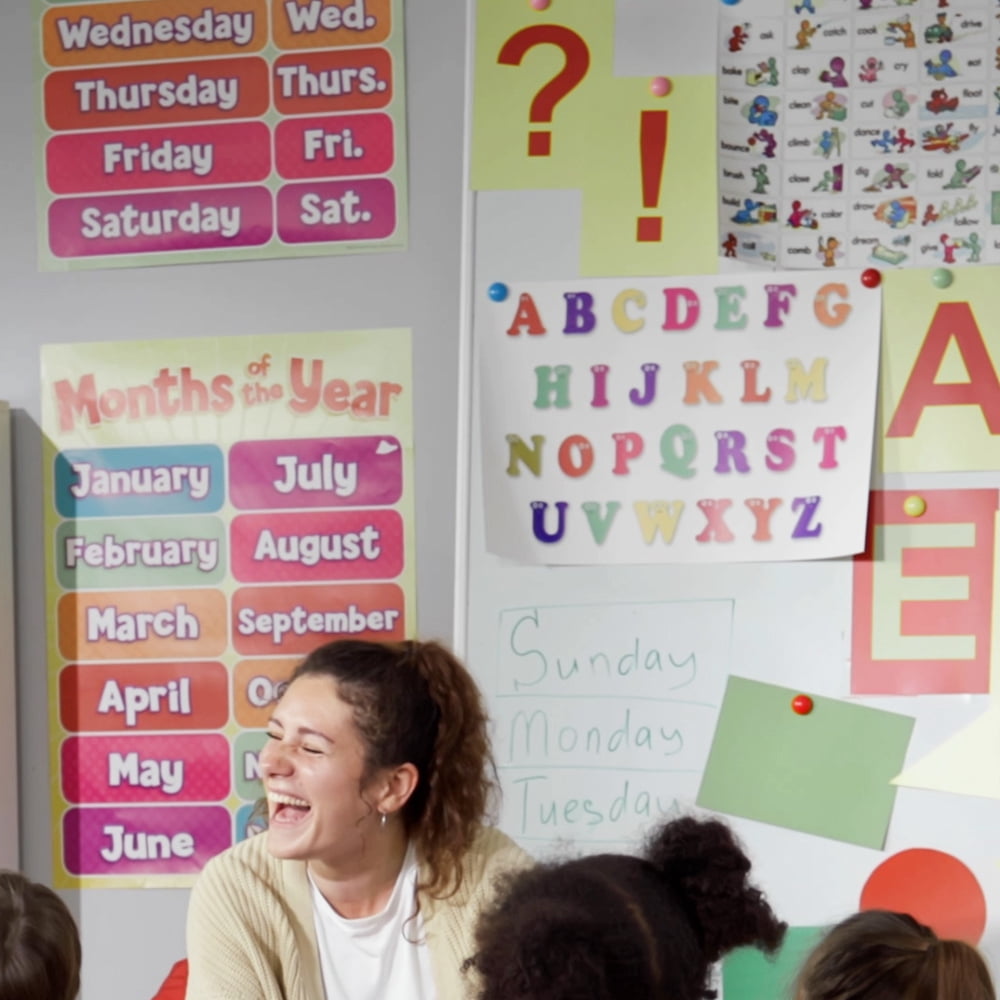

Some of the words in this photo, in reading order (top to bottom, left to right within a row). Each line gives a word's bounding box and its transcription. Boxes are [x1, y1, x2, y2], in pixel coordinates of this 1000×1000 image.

[56, 10, 254, 49] Wednesday
[285, 0, 376, 32] Wed.
[960, 19, 983, 29] drive
[74, 74, 238, 112] Thursday
[276, 64, 387, 97] Thurs.
[496, 23, 591, 157] ?
[103, 140, 213, 176] Friday
[303, 128, 363, 160] Fri.
[636, 109, 669, 242] !
[81, 202, 241, 239] Saturday
[300, 190, 371, 224] Sat.
[506, 292, 547, 336] A
[563, 292, 597, 335] B
[611, 288, 646, 333] C
[661, 287, 699, 331] D
[714, 285, 748, 331] E
[764, 284, 796, 328] F
[813, 283, 852, 327] G
[247, 353, 272, 376] of
[289, 357, 402, 417] Year
[533, 364, 572, 409] H
[590, 364, 610, 408] I
[629, 363, 660, 407] J
[682, 360, 723, 405] K
[741, 360, 772, 404] L
[784, 357, 829, 402] M
[884, 301, 1000, 439] A
[54, 366, 235, 431] Months
[241, 380, 283, 407] the
[505, 434, 546, 478] N
[557, 434, 594, 478] O
[611, 432, 644, 476] P
[660, 424, 698, 479] Q
[714, 430, 751, 474] R
[765, 428, 796, 472] S
[813, 425, 847, 470] T
[70, 463, 211, 499] January
[273, 454, 358, 497] July
[530, 501, 569, 544] U
[581, 501, 621, 546] V
[634, 500, 684, 545] W
[696, 499, 735, 543] X
[744, 498, 782, 542] Y
[791, 496, 823, 539] Z
[65, 535, 219, 572] February
[254, 525, 380, 566] August
[871, 522, 976, 661] E
[86, 604, 199, 642] March
[237, 605, 399, 644] September
[510, 608, 697, 692] Sunday
[98, 677, 191, 726] April
[509, 708, 684, 763] Monday
[108, 752, 184, 795] May
[100, 825, 195, 862] June
